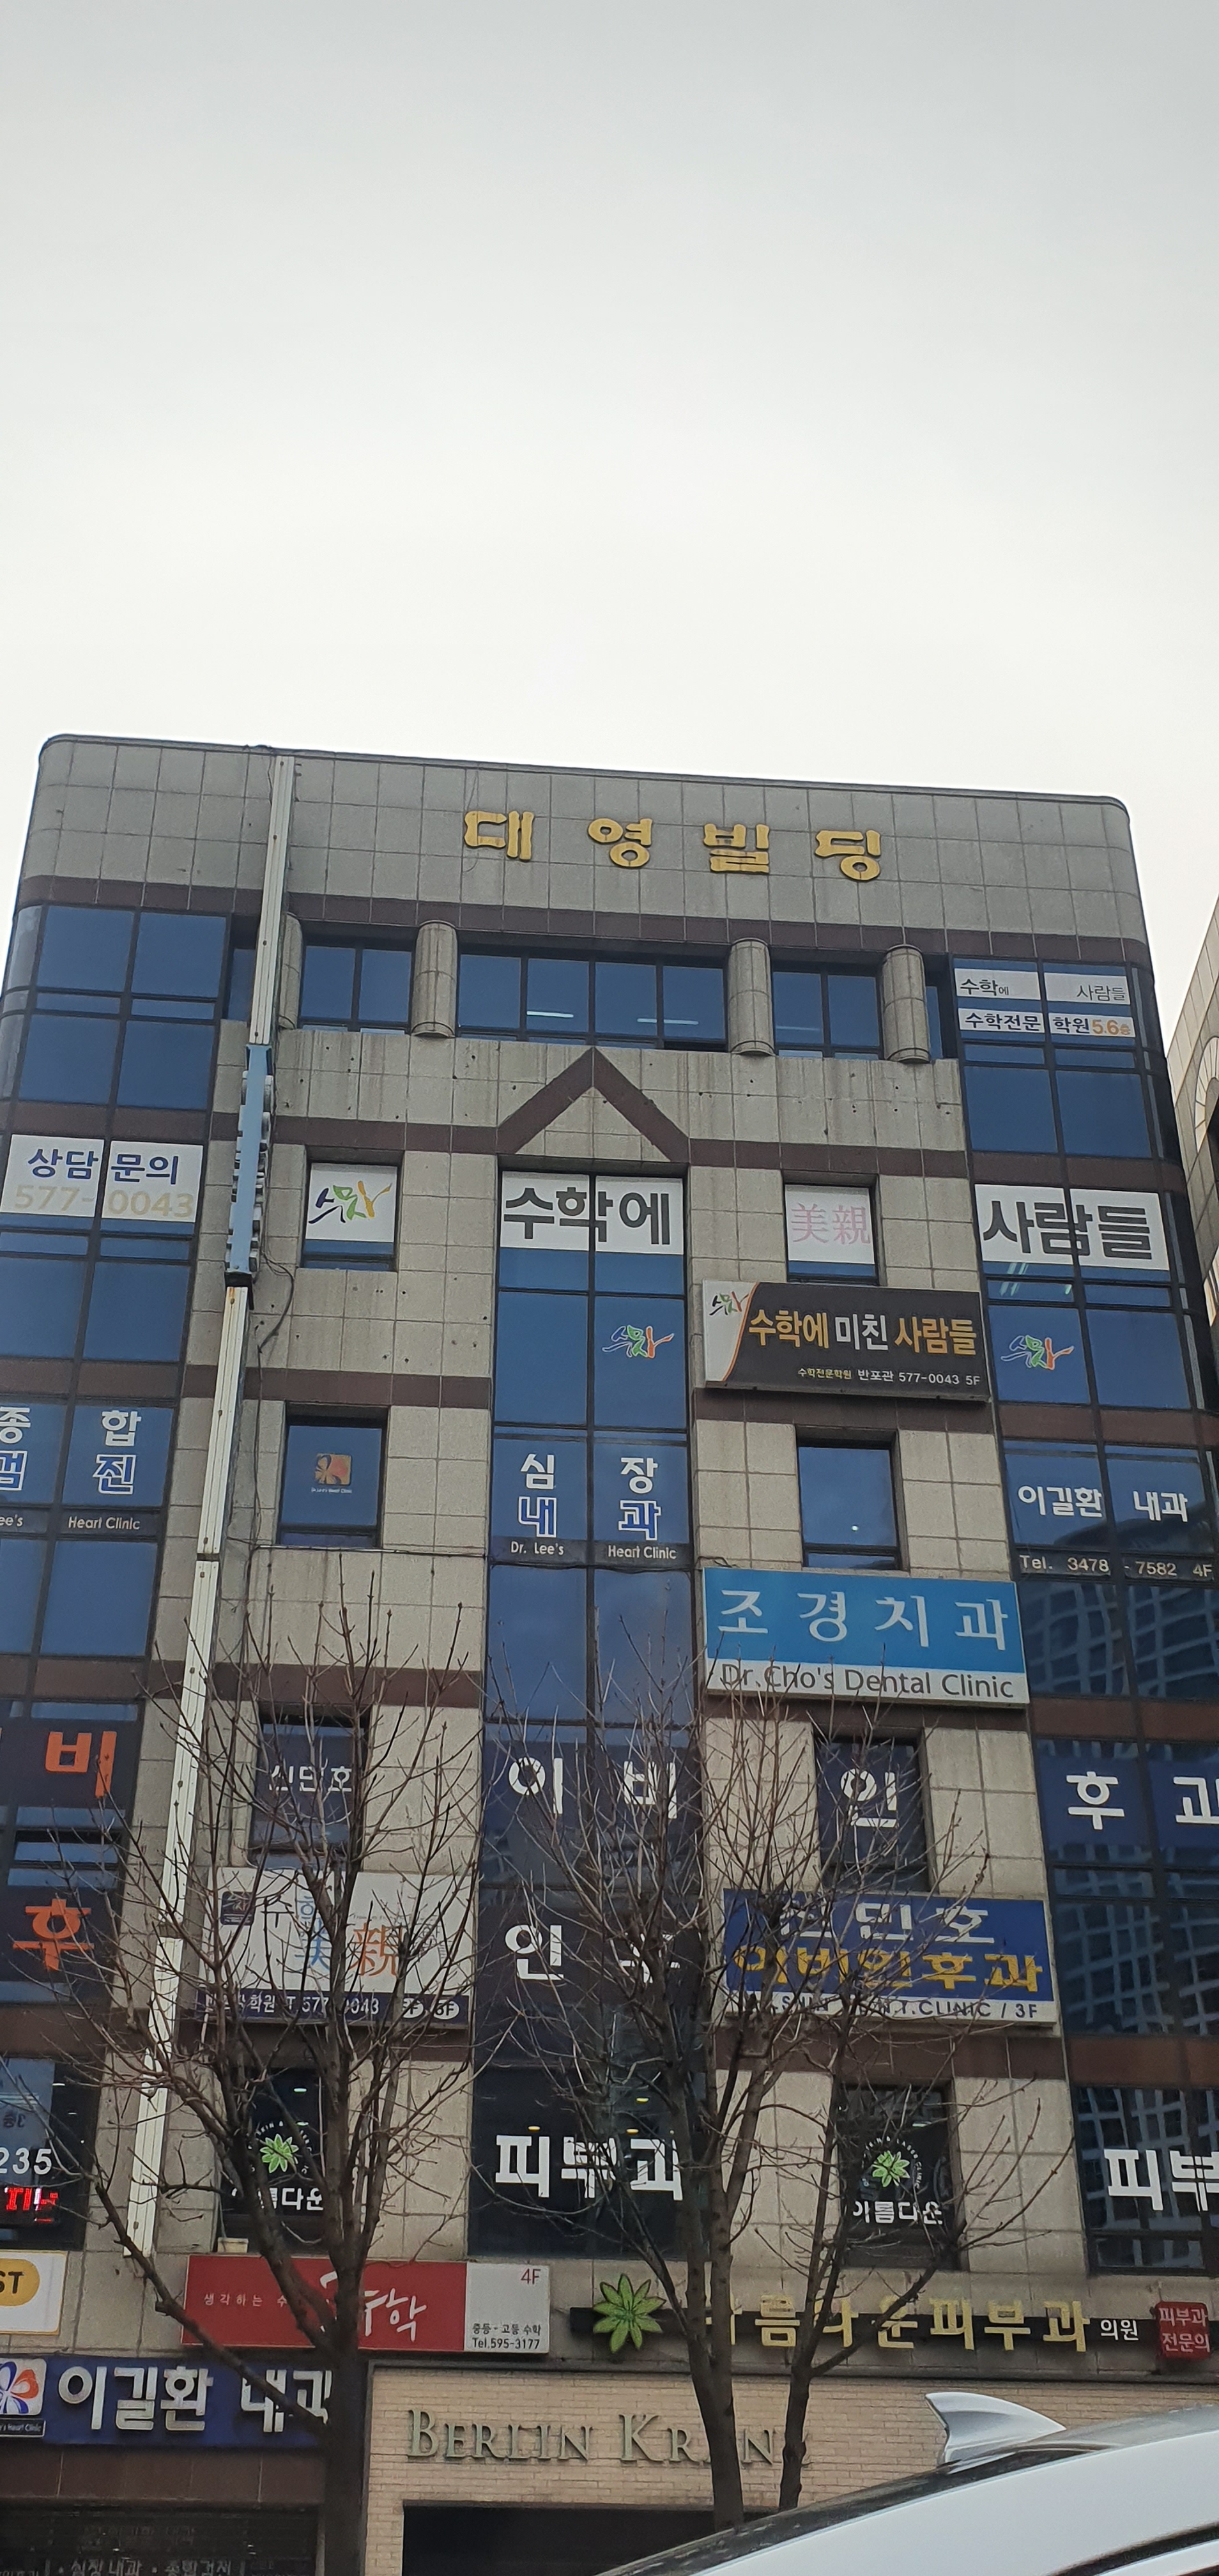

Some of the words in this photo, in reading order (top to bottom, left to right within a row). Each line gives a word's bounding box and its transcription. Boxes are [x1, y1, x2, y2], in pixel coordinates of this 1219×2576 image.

[960, 978, 1009, 996] 수학에
[1077, 985, 1126, 1001] 사람들
[965, 1012, 1041, 1032] 수학전문
[28, 1148, 99, 1180] 상담
[111, 1153, 179, 1185] 문의
[503, 1186, 671, 1245] 수학에
[983, 1200, 1153, 1261] 사람들
[748, 1308, 829, 1349] 수학에
[835, 1313, 889, 1351] 미친
[894, 1316, 977, 1356] 사람들
[858, 1369, 894, 1382] 반포관
[899, 1372, 960, 1385] 577-0043
[965, 1376, 980, 1386] 5F
[1018, 1485, 1103, 1518] 이길환
[1133, 1491, 1188, 1522] 내과
[0, 1514, 23, 1528] ee's
[68, 1516, 102, 1529] Heart
[106, 1517, 141, 1530] Clinic
[510, 1541, 527, 1554] Dr.
[534, 1542, 564, 1556] Lee's
[608, 1545, 640, 1558] Heart
[643, 1545, 677, 1560] Clinic
[1020, 1554, 1054, 1569] Tel.
[1192, 1564, 1212, 1577] 4F
[718, 1589, 1008, 1651] 조경치과
[845, 1669, 931, 1694] Dental
[942, 1673, 1013, 1698] Clinic
[733, 1945, 1043, 1992] 이비인후과
[1015, 2004, 1037, 2018] 3F
[495, 2135, 684, 2202] 피부과
[521, 2268, 541, 2285] 4F
[1101, 2319, 1139, 2341] 의원
[1159, 2308, 1208, 2327] 피부과
[1162, 2333, 1211, 2353] 전문의
[59, 2366, 213, 2431] 이길환
[618, 2414, 809, 2466] KRN
